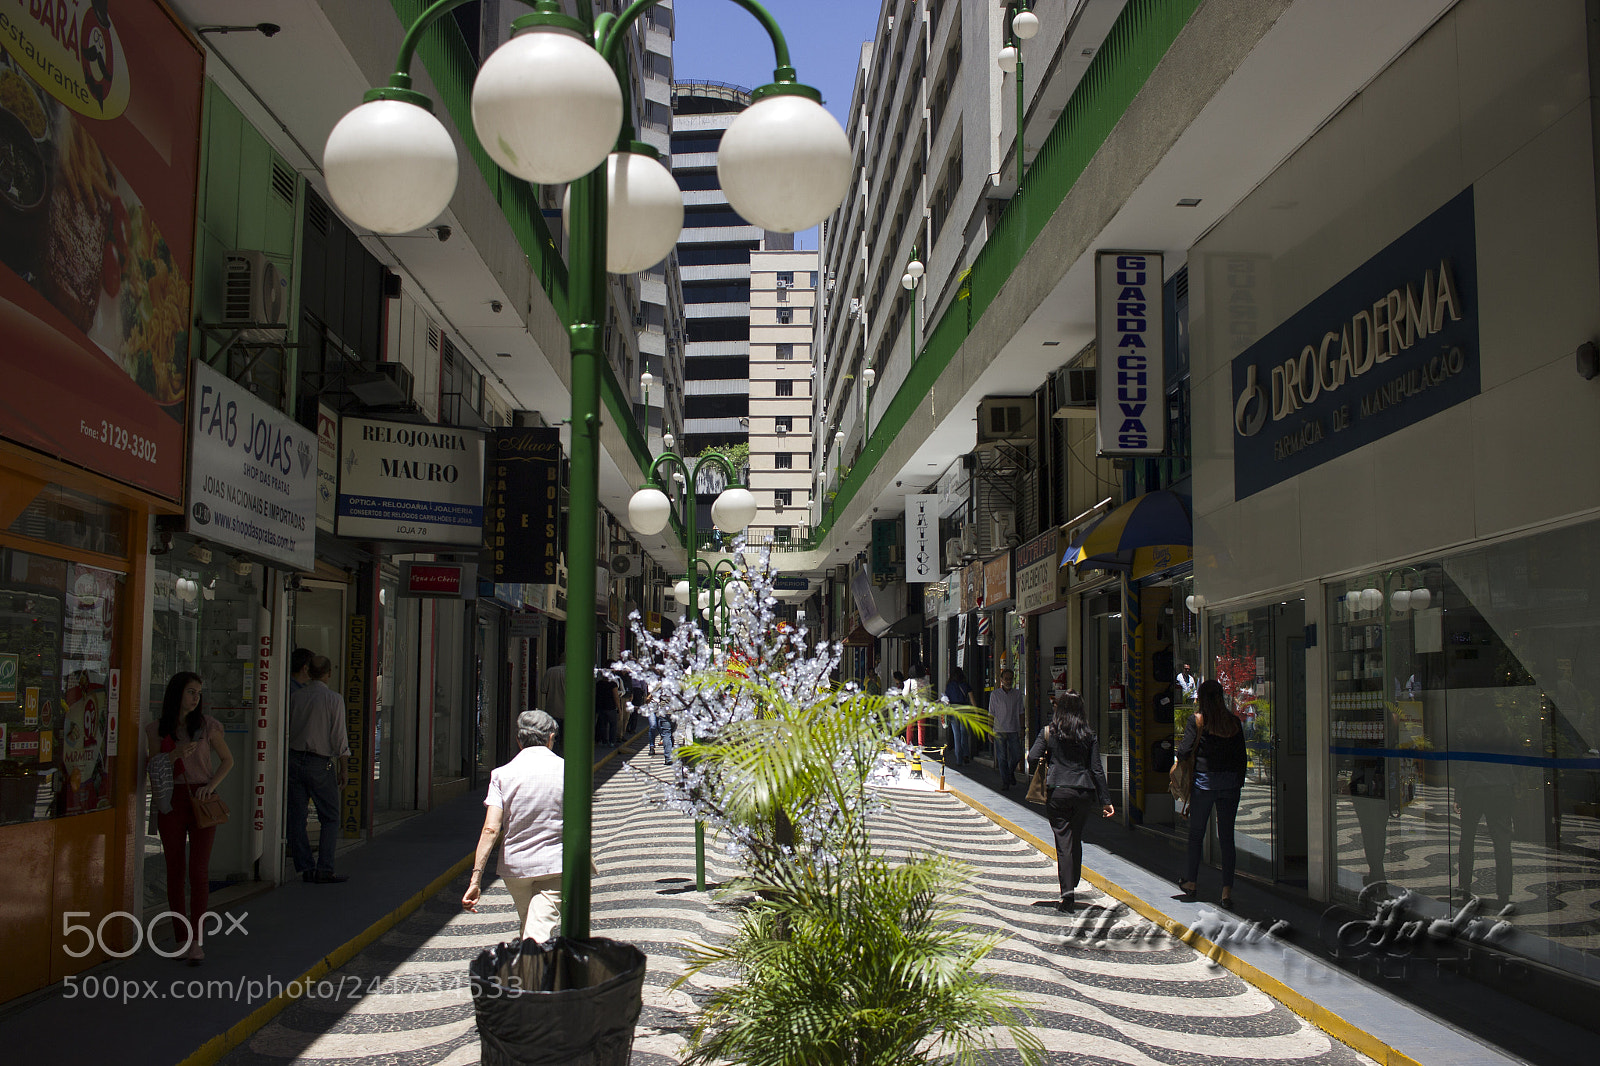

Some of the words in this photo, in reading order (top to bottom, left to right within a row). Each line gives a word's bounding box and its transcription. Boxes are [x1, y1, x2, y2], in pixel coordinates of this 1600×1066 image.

[0, 12, 89, 104] estaurante
[1271, 258, 1462, 421] DROGADERMA
[1333, 404, 1350, 433] DE
[1360, 344, 1465, 419] MANIPULAÇÃO
[81, 419, 99, 440] Fone:
[101, 420, 157, 464] 3129-3302
[199, 384, 238, 448] FAB
[244, 412, 293, 475] JOIAS
[362, 425, 466, 451] RELOJOARIA
[243, 462, 260, 480] SHOP
[260, 471, 271, 488] DAS
[271, 476, 291, 496] PRATAS
[380, 458, 459, 483] MAURO
[203, 474, 225, 499] JOIAS
[227, 484, 263, 515] NACIONAIS
[263, 500, 269, 517] E
[269, 501, 307, 532] IMPORTADAS
[382, 500, 428, 511] RELOJOARIA
[433, 505, 474, 516] JOALHERIA
[521, 513, 529, 528] E
[544, 466, 556, 576] BOLSAS
[213, 510, 297, 552] www.shopdaspratas.com.br
[396, 525, 416, 534] LOJA
[417, 526, 427, 536] 78
[916, 500, 930, 576] TATTOO
[1017, 530, 1057, 569] NUTRIFIT
[258, 636, 271, 729] CONSERTO
[41, 737, 51, 756] Up
[257, 740, 267, 762] DE
[253, 773, 265, 832] JOIAS
[347, 777, 359, 787] E
[345, 790, 358, 833] JOIAS
